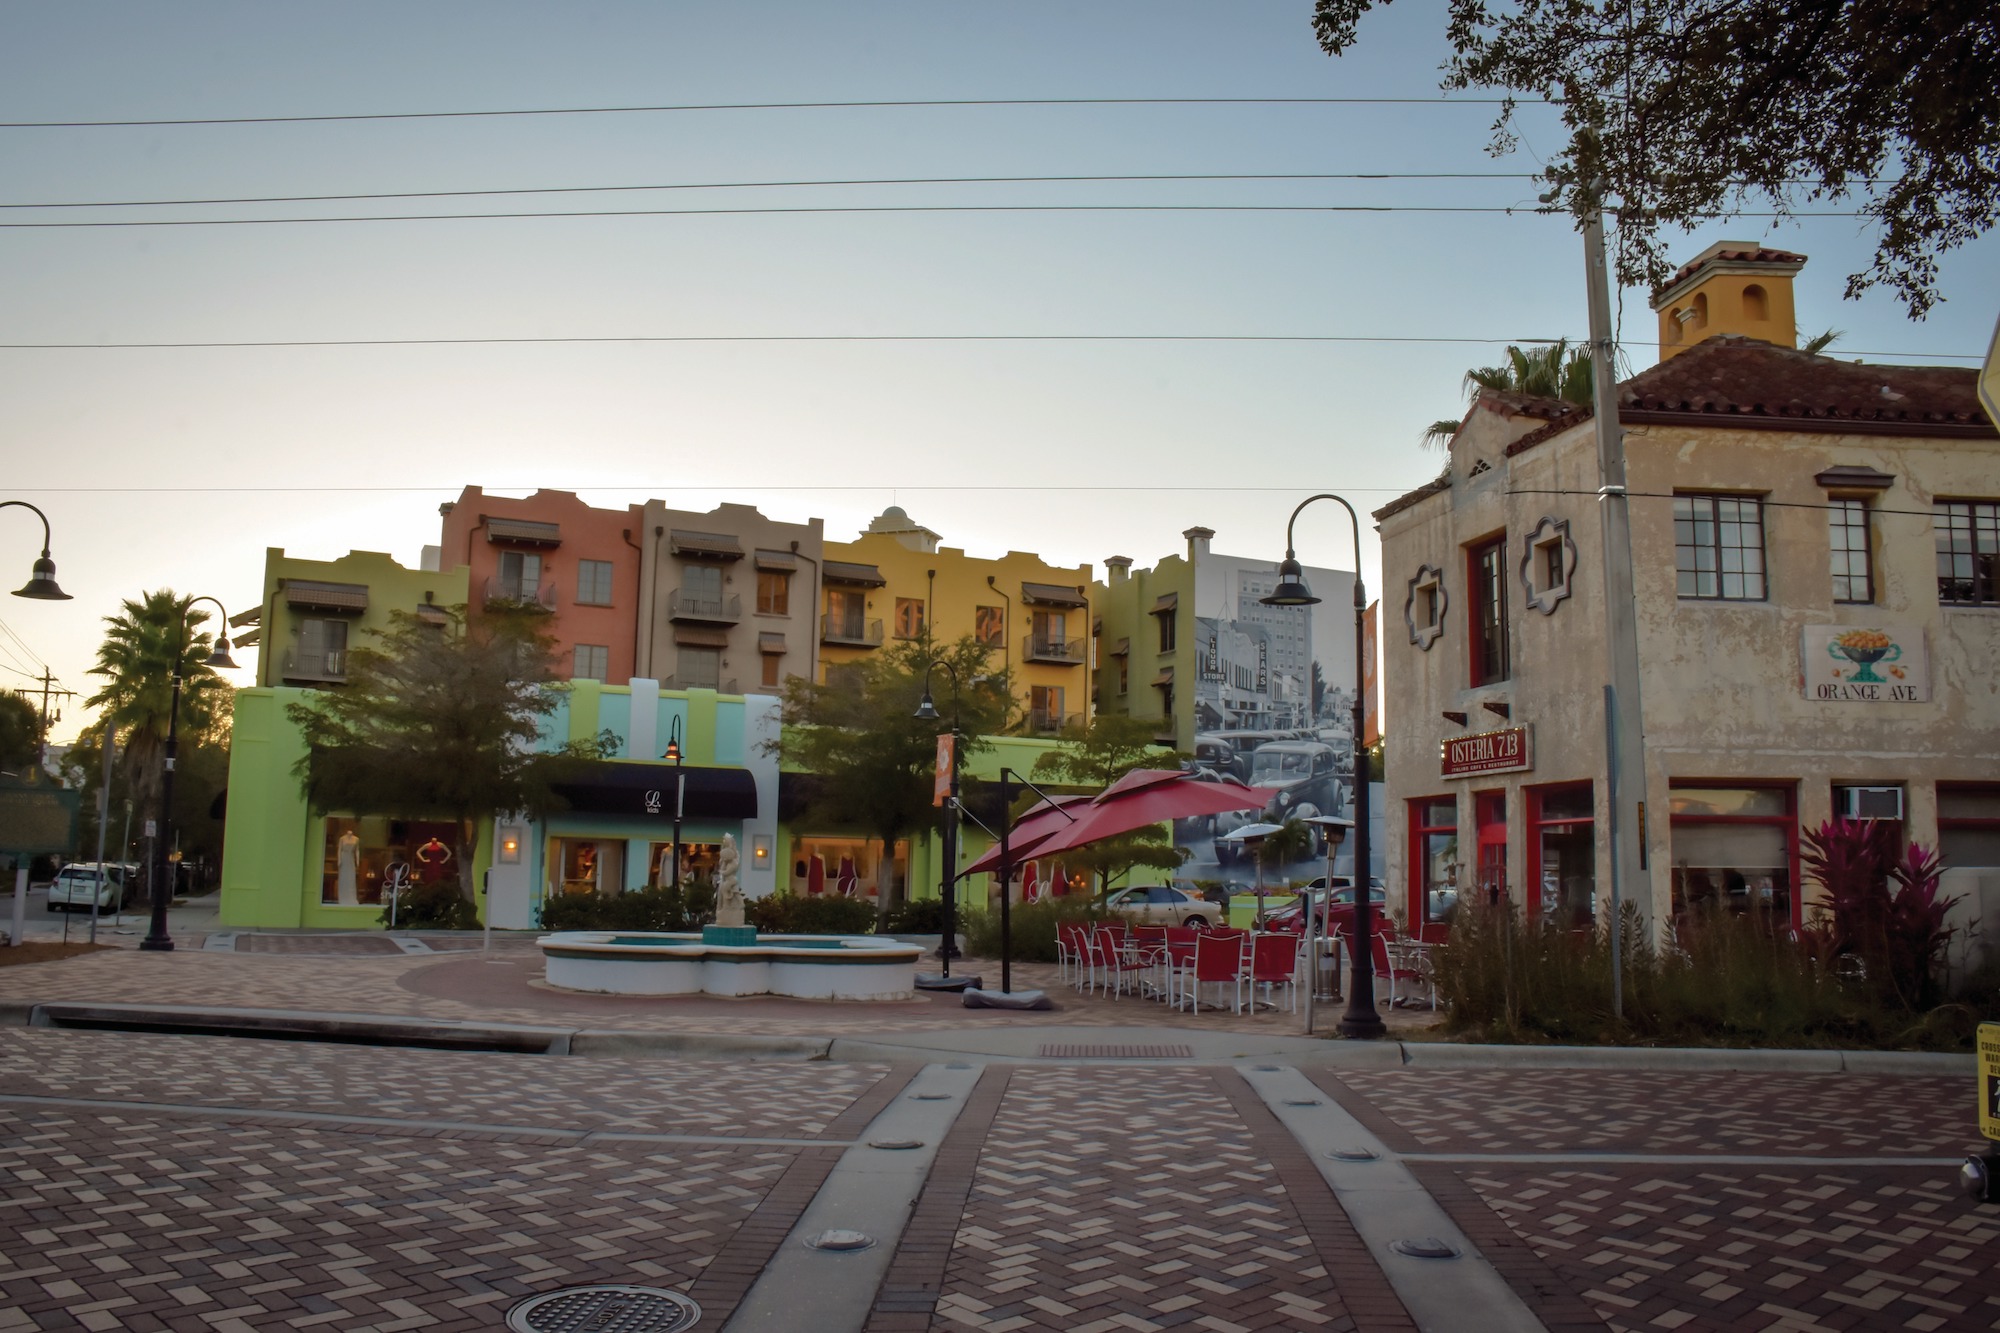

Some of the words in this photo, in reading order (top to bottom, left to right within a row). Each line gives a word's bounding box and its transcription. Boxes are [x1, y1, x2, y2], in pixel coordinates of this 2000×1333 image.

[1203, 672, 1226, 680] STORE
[1817, 683, 1880, 700] ORANGE
[1888, 685, 1918, 701] AVE
[1451, 738, 1495, 764] OSTERIA
[1497, 733, 1518, 757] 7.13
